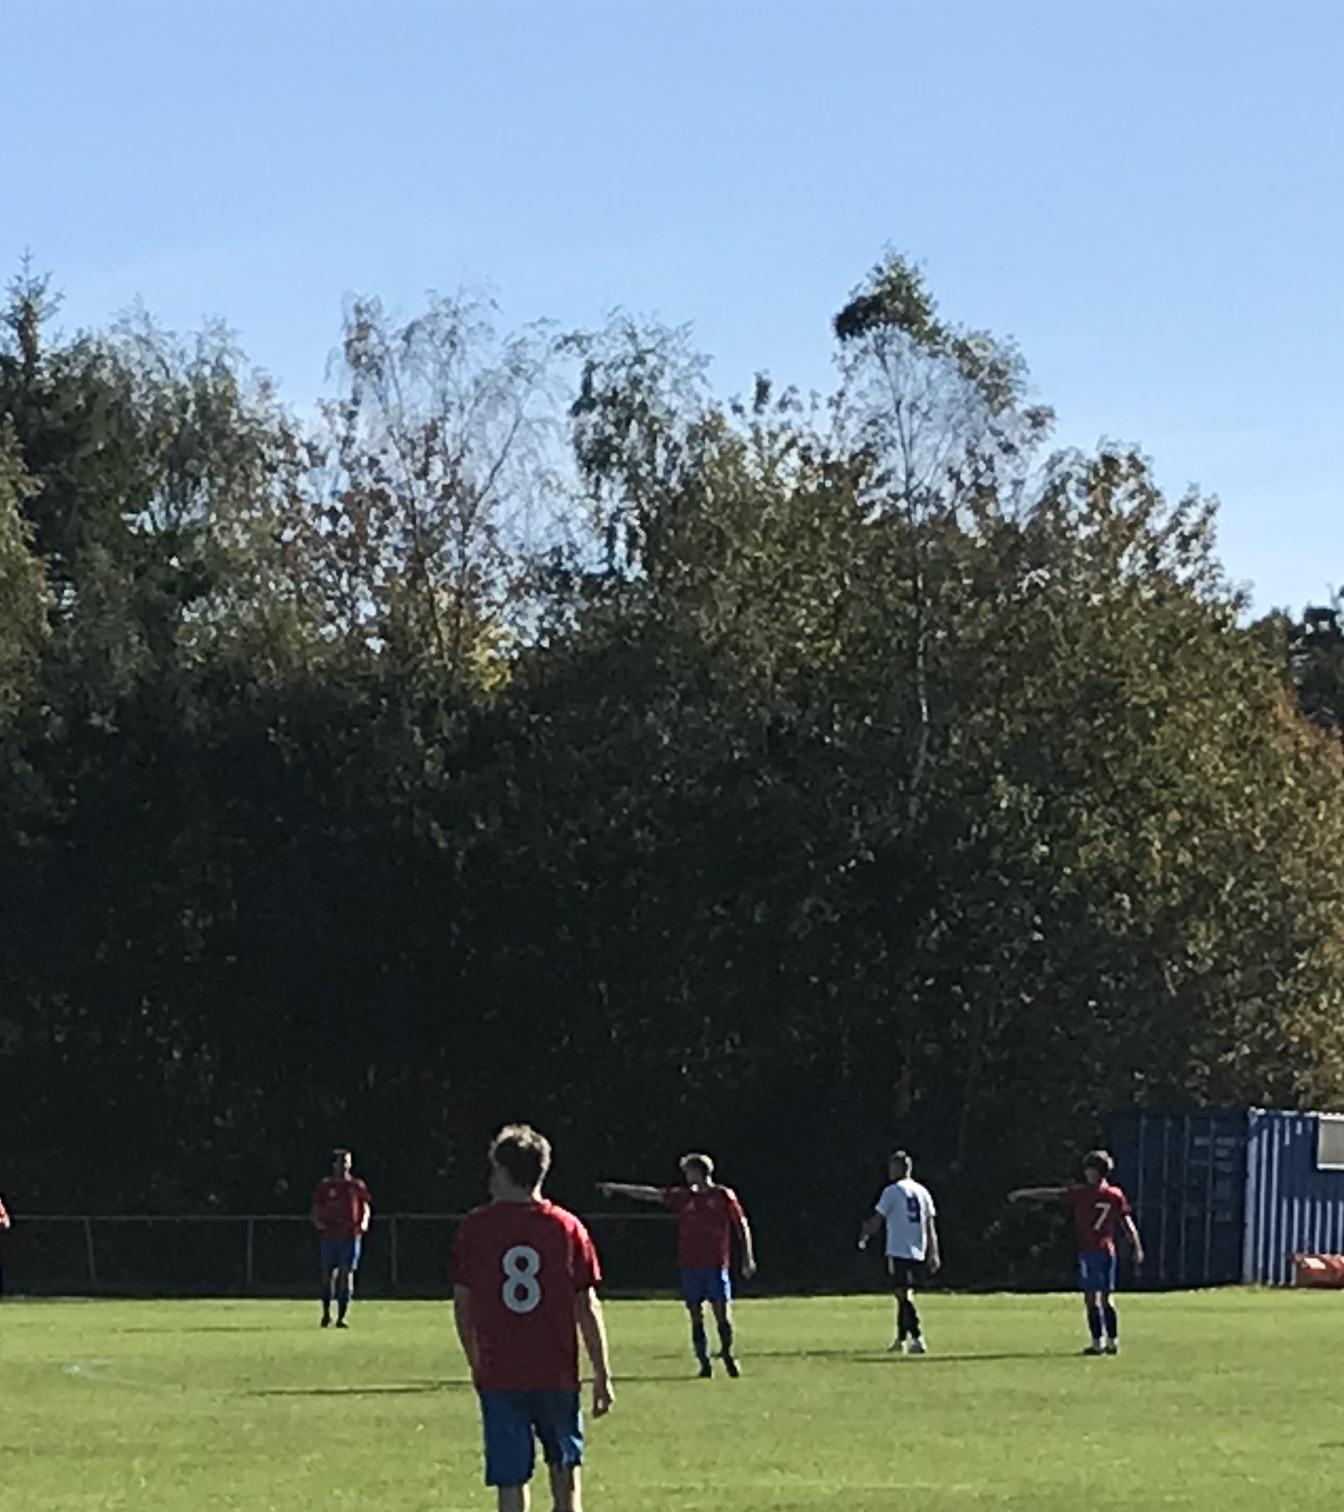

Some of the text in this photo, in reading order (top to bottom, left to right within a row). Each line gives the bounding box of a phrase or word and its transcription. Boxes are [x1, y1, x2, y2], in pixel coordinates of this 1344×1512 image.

[906, 1194, 921, 1223] 9
[1094, 1202, 1111, 1230] 7
[502, 1245, 541, 1314] 8
